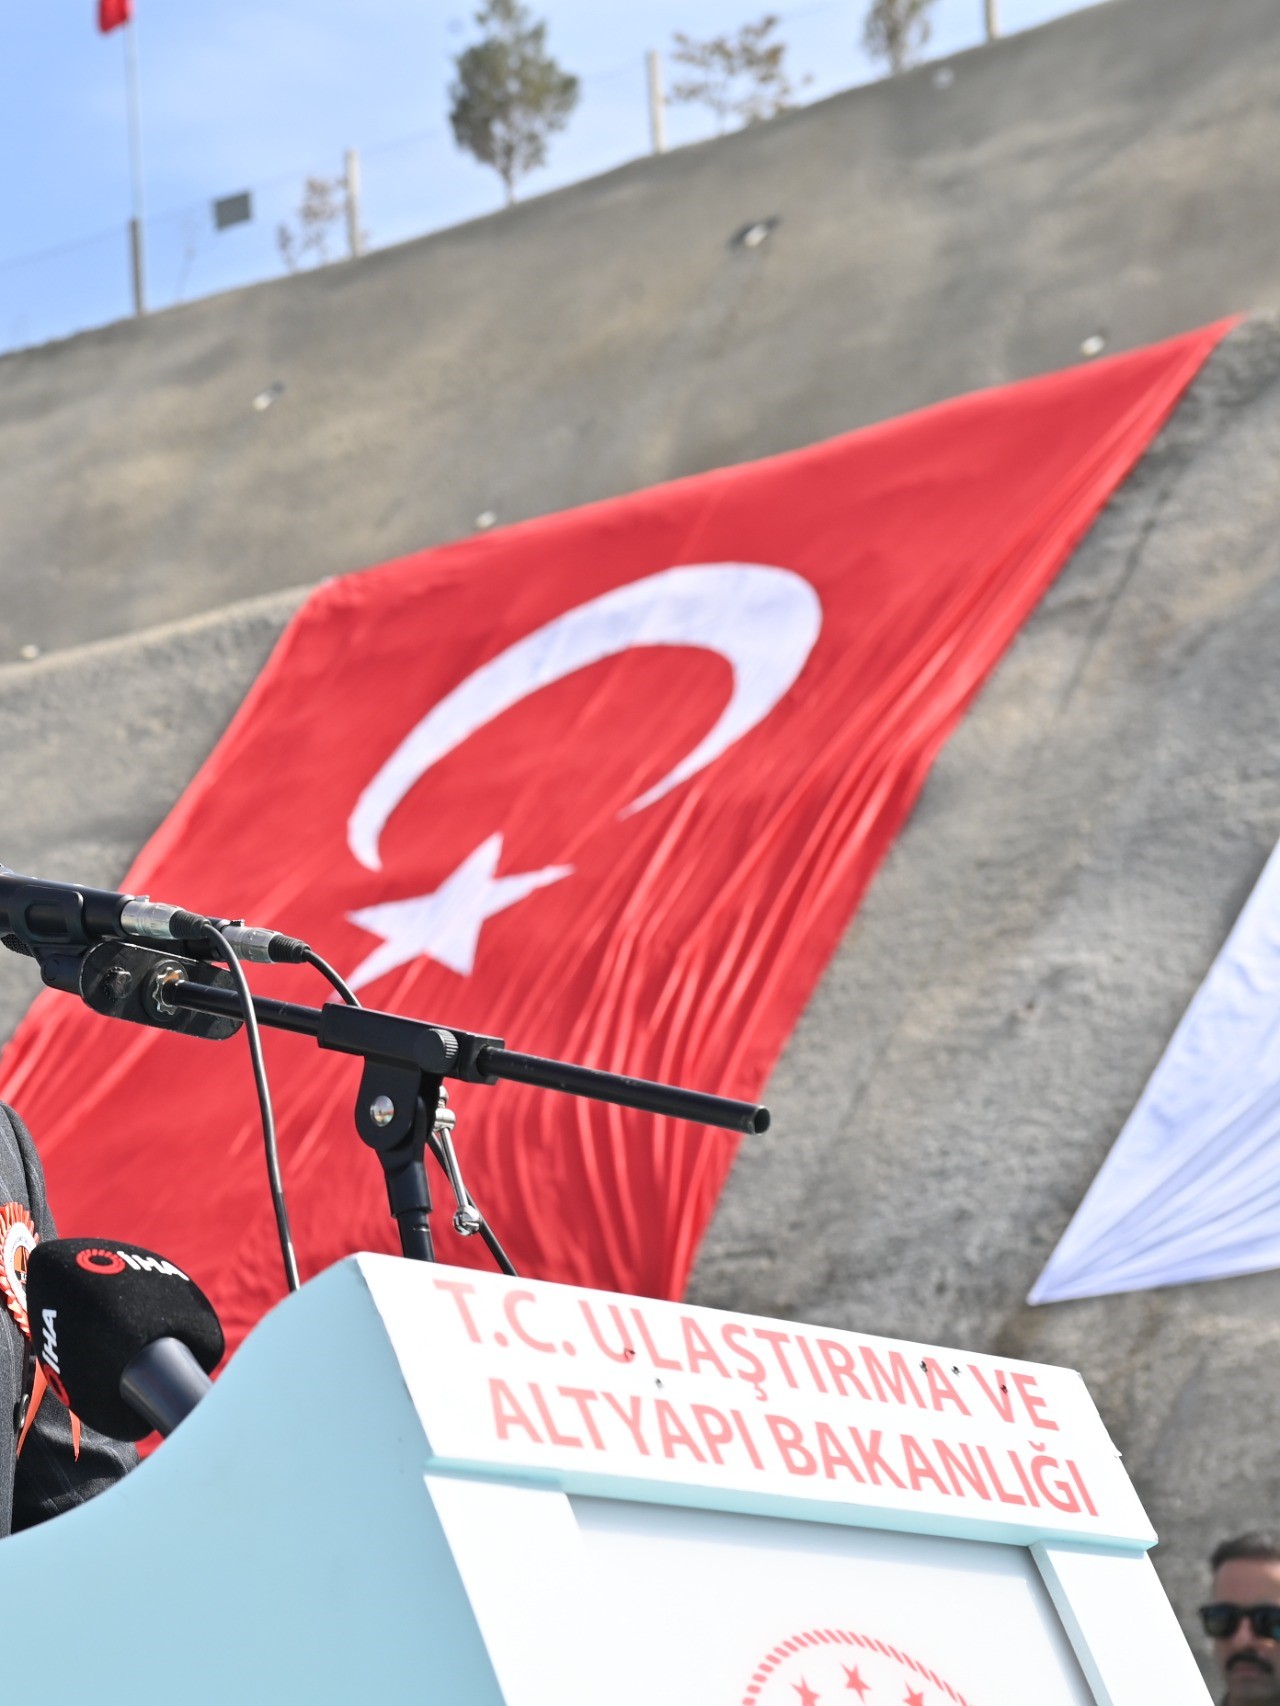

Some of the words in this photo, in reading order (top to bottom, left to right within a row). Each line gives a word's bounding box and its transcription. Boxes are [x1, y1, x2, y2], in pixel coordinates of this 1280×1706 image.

[433, 1279, 577, 1357] T.C.
[578, 1300, 972, 1417] ULAŞTIRMA
[967, 1364, 1060, 1431] VE
[488, 1377, 766, 1471] ALTYAPI
[765, 1414, 1100, 1517] BAKANLIĞI
